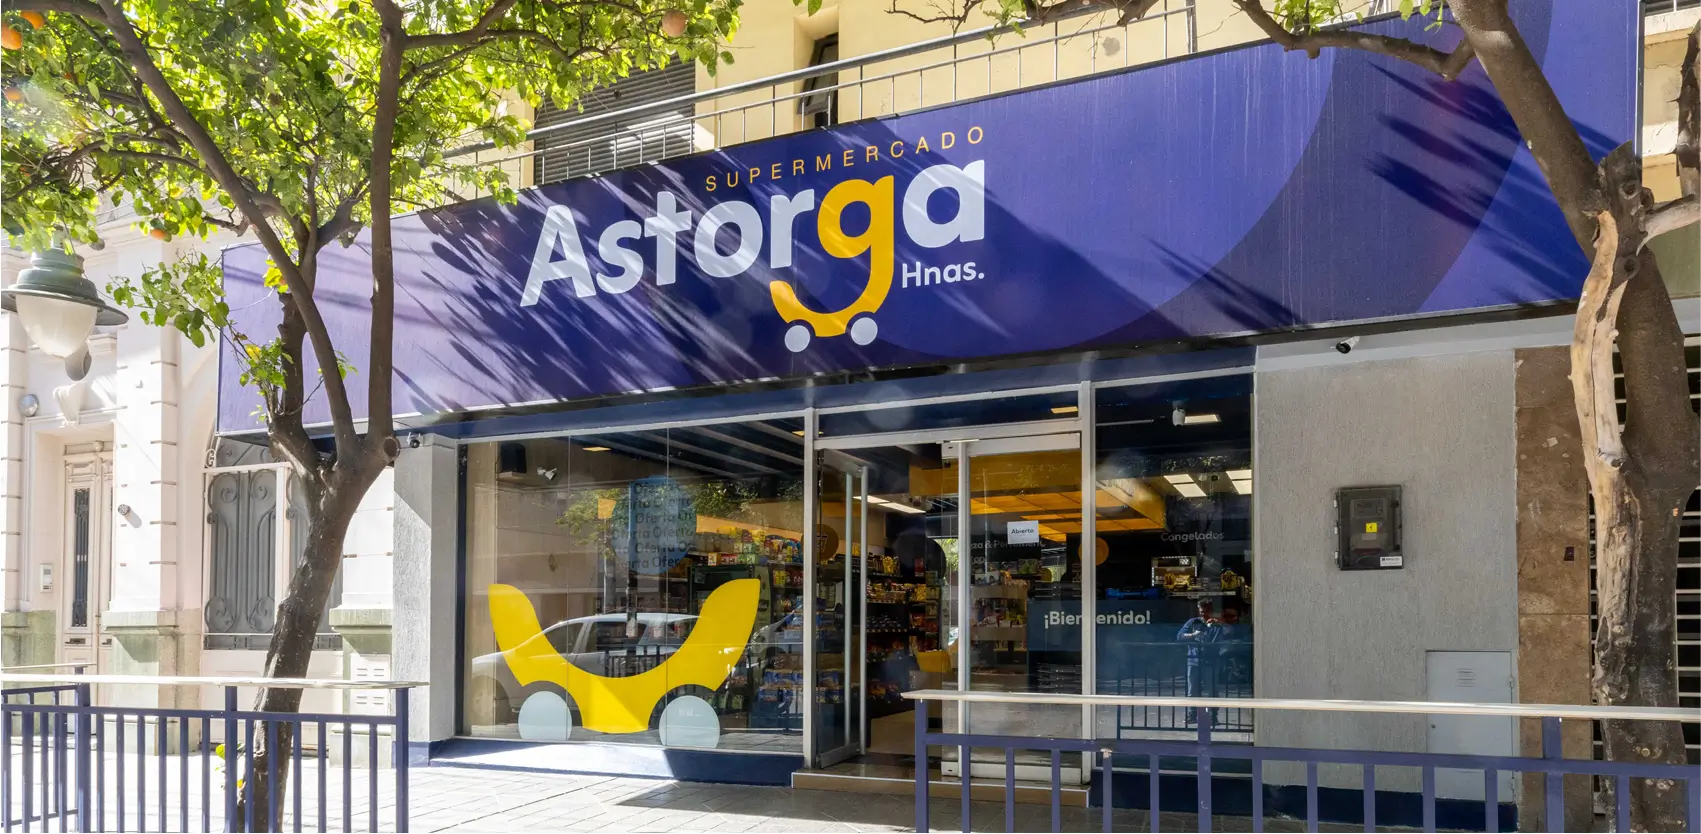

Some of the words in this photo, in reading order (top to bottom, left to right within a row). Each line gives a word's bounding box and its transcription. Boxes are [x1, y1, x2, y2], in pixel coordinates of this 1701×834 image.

[705, 126, 985, 192] SUPERMERCADO
[520, 159, 985, 338] Astorga
[902, 260, 985, 289] Hnas.
[1160, 531, 1225, 543] Congelados
[1044, 609, 1151, 630] ¡Bienenido!
